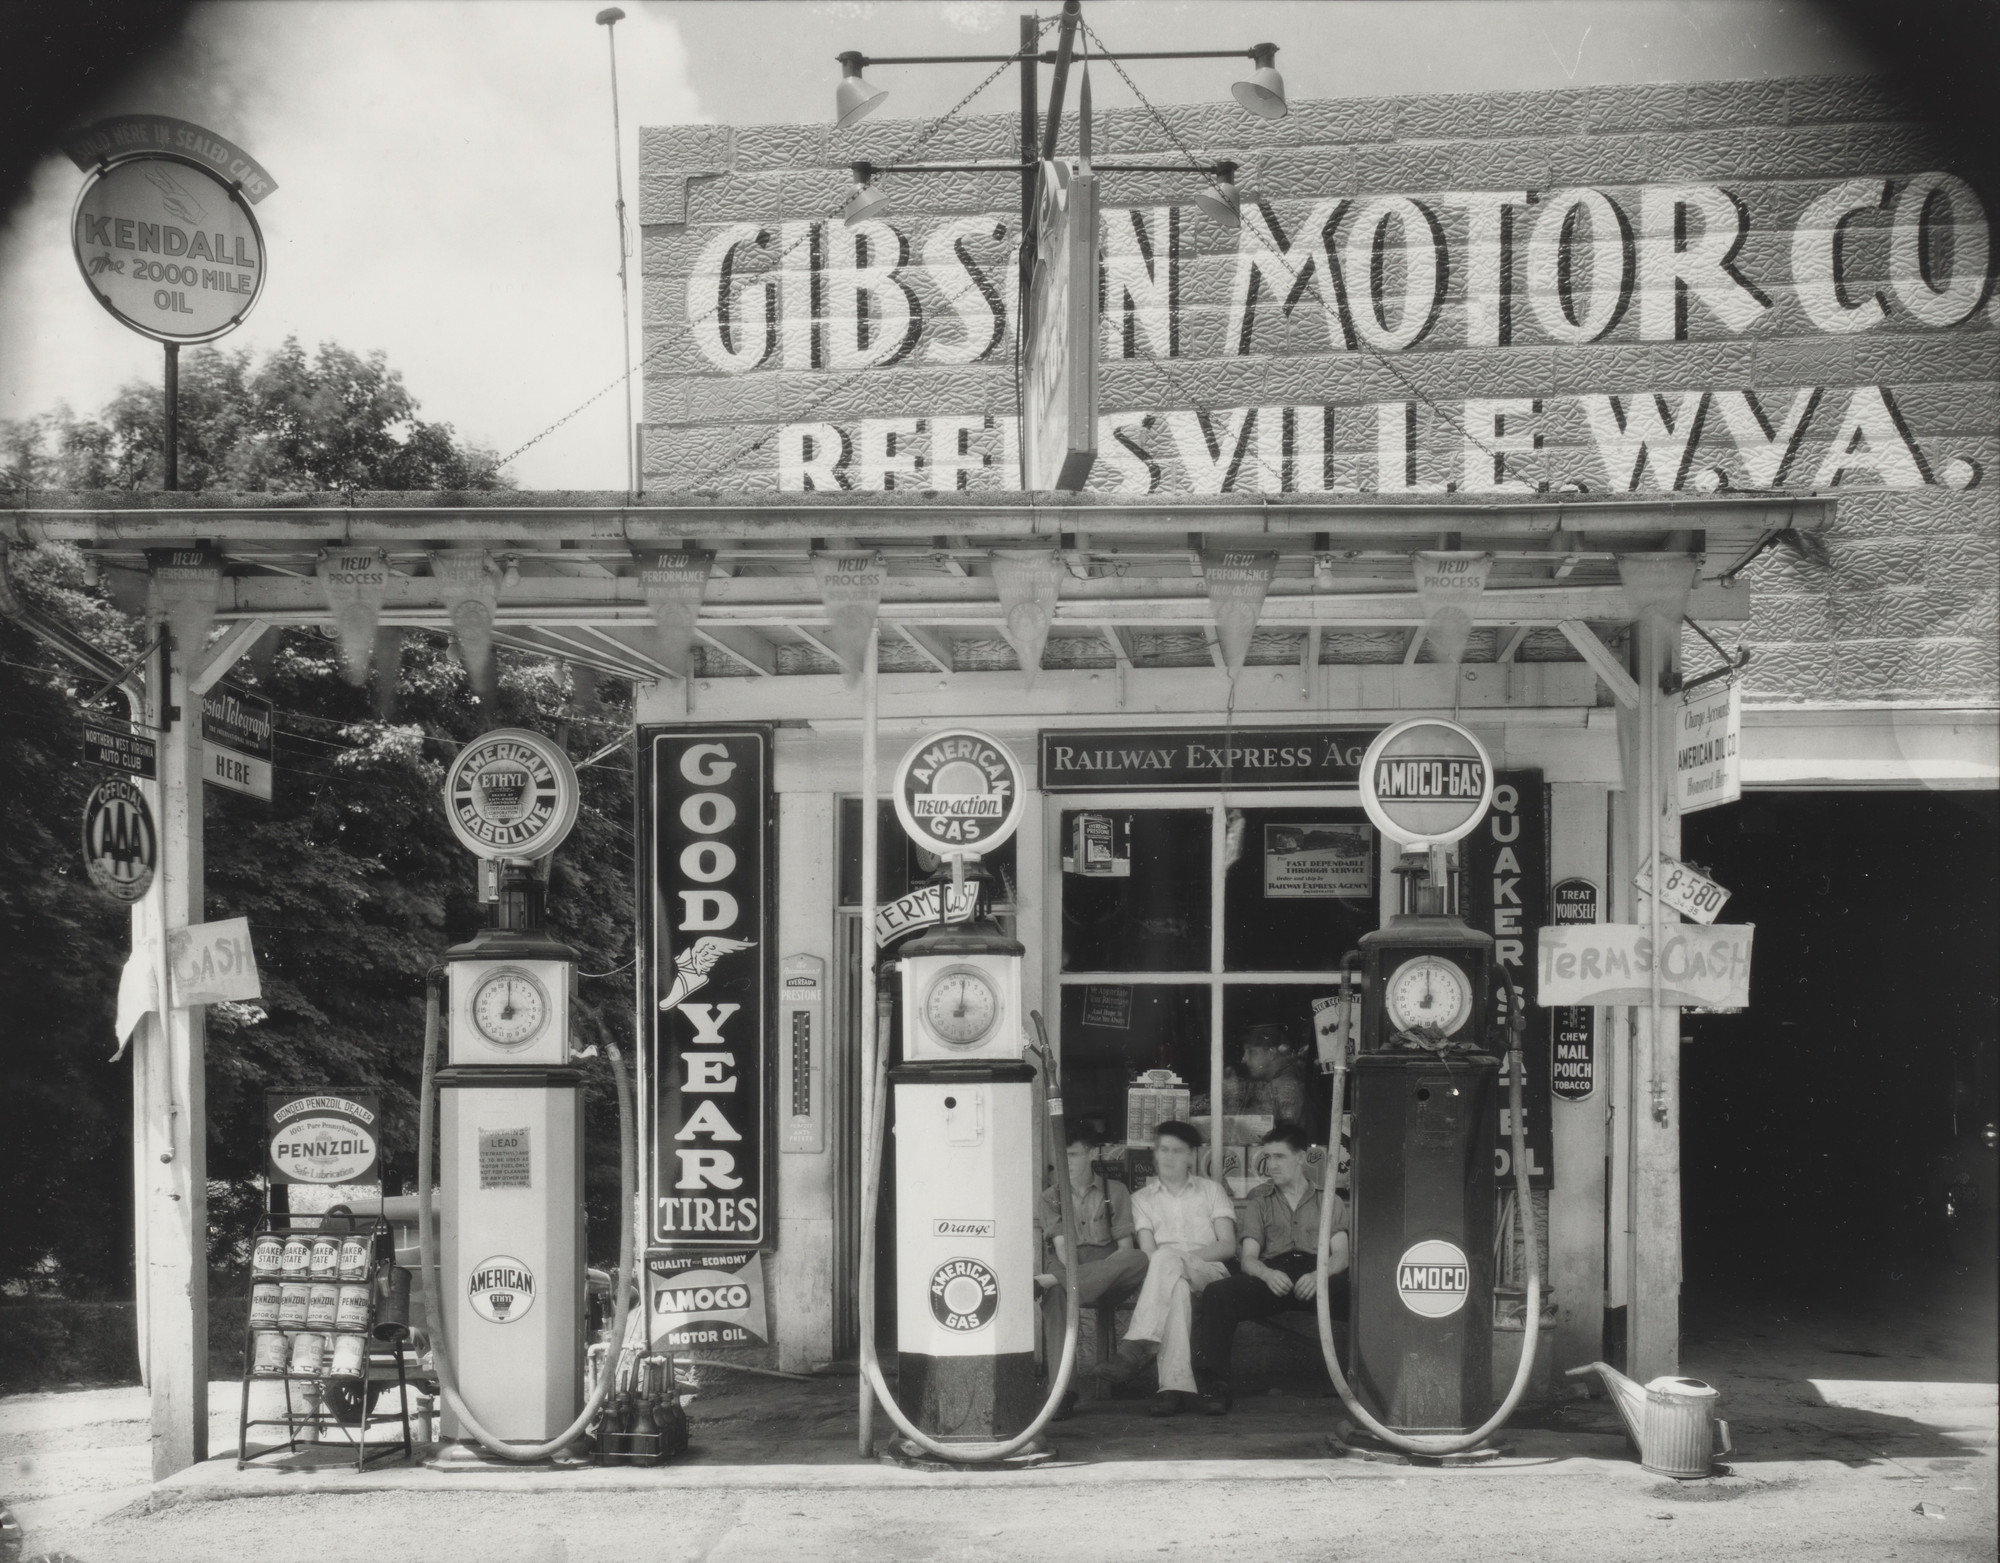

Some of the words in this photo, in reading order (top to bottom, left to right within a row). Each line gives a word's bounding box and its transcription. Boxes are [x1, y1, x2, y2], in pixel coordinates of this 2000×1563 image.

[113, 124, 147, 145] HERE
[154, 124, 169, 144] IN
[176, 129, 228, 164] SEALED
[229, 159, 268, 195] CANS
[85, 213, 255, 267] KENDALL
[89, 251, 124, 276] The
[133, 258, 198, 286] 2000
[202, 269, 251, 294] MILE
[688, 204, 1180, 373] GIBSN
[1225, 186, 1773, 355] MOTOR
[154, 290, 193, 313] OIL
[172, 552, 203, 566] NEW
[341, 556, 371, 570] NEW
[658, 554, 689, 568] NEW
[837, 558, 868, 572] NEW
[1223, 553, 1255, 567] NEW
[1437, 560, 1469, 574] NEW
[157, 567, 218, 580] PERFORMANCE
[329, 573, 383, 585] PROCESS
[642, 570, 705, 583] PERFORMANCE
[825, 574, 879, 586] PROCESS
[1206, 568, 1270, 581] PERFORMANCE
[1424, 576, 1480, 588] PROCESS
[202, 694, 226, 721] ostal
[226, 696, 270, 742] Telegraph
[1685, 710, 1705, 732] Charge
[1706, 699, 1730, 724] Accounts
[86, 729, 114, 749] NORTHERN
[115, 736, 130, 752] WEST
[130, 740, 154, 759] VIRGINIA
[100, 748, 120, 764] AUTO
[122, 753, 142, 770] CLUB
[1054, 746, 1178, 770] RAILWAY
[1186, 744, 1312, 769] EXPRESS
[1678, 740, 1713, 772] AMERICAN
[1715, 737, 1725, 761] OIL
[216, 754, 250, 785] HERE
[460, 744, 552, 785] AMERICAN
[912, 739, 1011, 796] AMERICAN
[481, 773, 526, 788] ETHYL
[1378, 762, 1482, 796] AMOCO-GAS
[1687, 772, 1714, 796] Honored
[98, 782, 143, 814] OFFICIAL
[460, 802, 552, 844] GASOLINE
[930, 816, 980, 841] GAS
[101, 801, 144, 878] AAA
[1491, 784, 1524, 967] QUAKER
[1561, 891, 1591, 900] TREAT
[1666, 869, 1722, 913] 8-580
[1556, 904, 1596, 919] YOURSELF
[674, 743, 743, 1190] GOODYEAR
[781, 989, 821, 1001] PRESTONE
[1560, 1032, 1588, 1042] CHEW
[1557, 1045, 1589, 1060] MAIL
[1554, 1063, 1591, 1078] POUCH
[1554, 1081, 1591, 1089] TOBACCO
[276, 1100, 305, 1121] BONDED
[306, 1098, 342, 1109] PENNZOIL
[344, 1101, 373, 1122] DEALER
[289, 1126, 305, 1136] 100%
[322, 1122, 359, 1137] Pennsylvania
[278, 1139, 370, 1159] PENNZOIL
[491, 1138, 518, 1148] LEAD
[1495, 1148, 1545, 1176] OL
[293, 1164, 310, 1177] Safe
[310, 1167, 355, 1179] Lubrication
[659, 1198, 758, 1232] TIRES
[938, 1221, 991, 1236] Orange
[257, 1247, 283, 1256] QUAKER
[259, 1255, 280, 1264] STATE
[283, 1255, 302, 1264] STATE
[651, 1258, 692, 1271] QUALITY
[702, 1255, 747, 1266] ECONOMY
[469, 1268, 532, 1295] AMERICAN
[931, 1262, 996, 1296] AMERICAN
[1401, 1265, 1467, 1291] AMOCO
[253, 1295, 281, 1305] PENNZOIL
[281, 1295, 306, 1305] ENNZOIL
[658, 1286, 748, 1313] AMOCO
[945, 1313, 981, 1329] GAS
[668, 1331, 718, 1345] MOTOR
[722, 1328, 747, 1341] OIL
